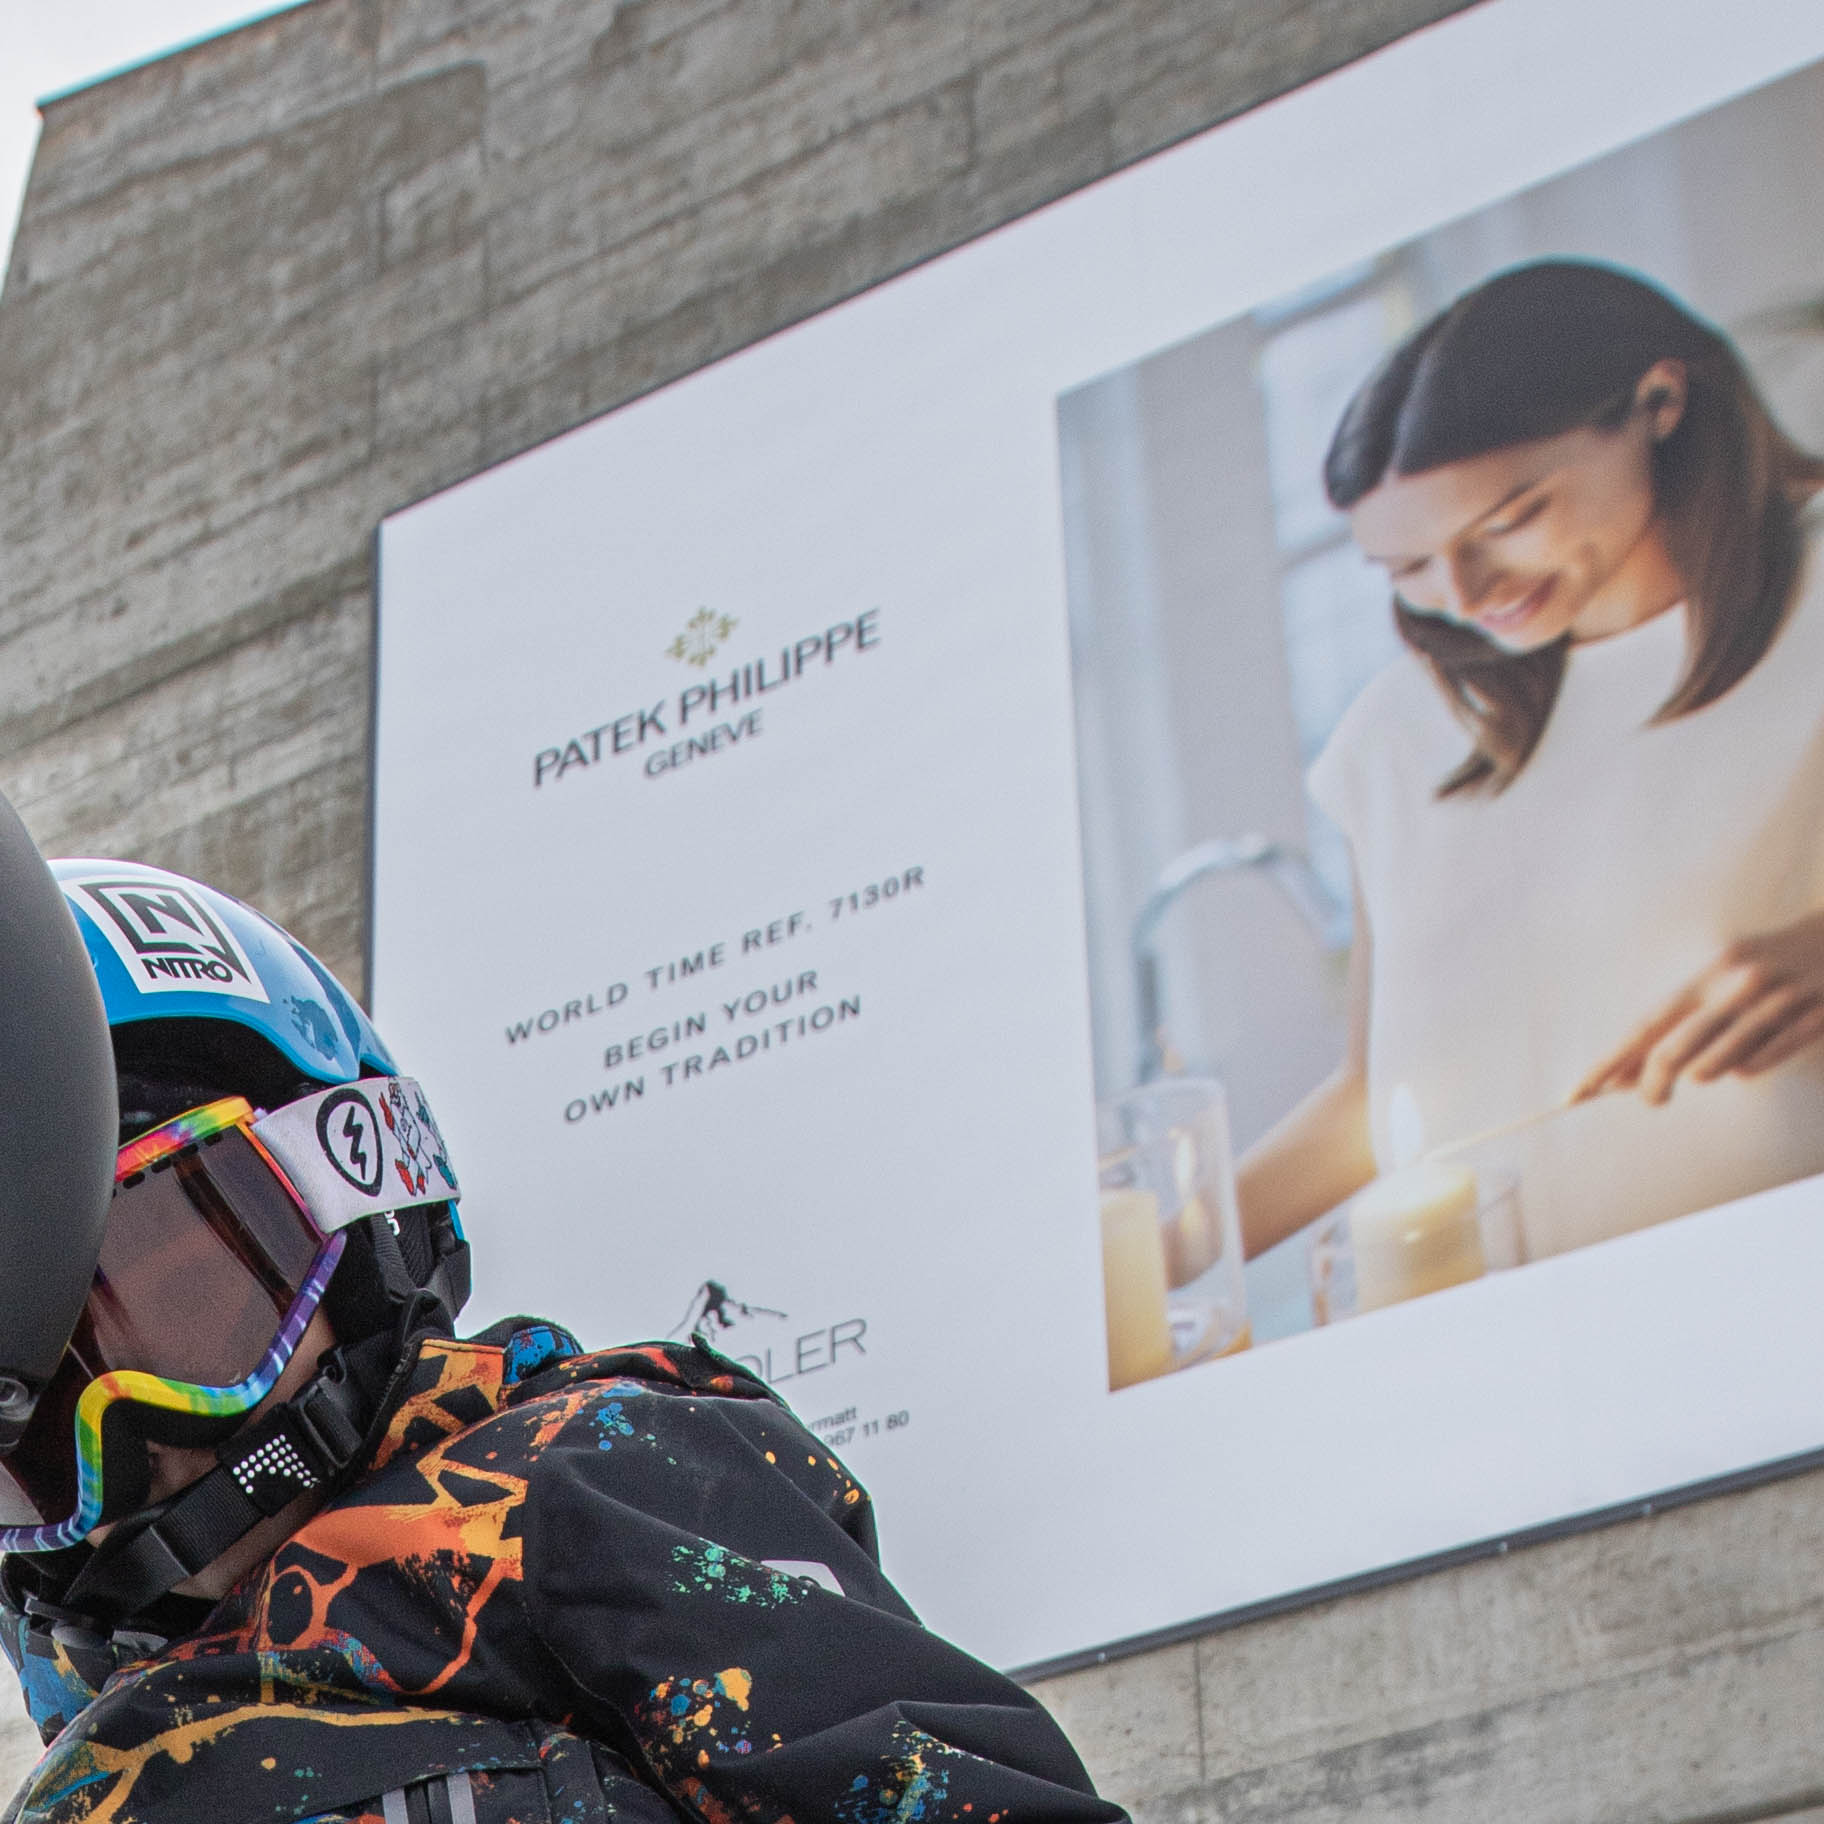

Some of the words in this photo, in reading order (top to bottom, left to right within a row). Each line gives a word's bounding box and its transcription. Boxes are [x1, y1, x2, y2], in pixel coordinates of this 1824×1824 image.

[533, 699, 667, 790] PATEK
[677, 608, 881, 726] PHILIPPE
[643, 707, 764, 780] GENEVE
[141, 957, 233, 983] NITRO
[504, 981, 630, 1046] WORLD
[643, 942, 727, 991] TIME
[740, 911, 814, 955] REF.
[829, 865, 925, 919] 7130R
[563, 1076, 646, 1125] OWN
[659, 995, 862, 1088] TRADITION
[602, 1012, 707, 1070] BEGIN
[719, 969, 820, 1023] YOUR
[863, 1418, 880, 1436] 11
[887, 1409, 910, 1431] 80
